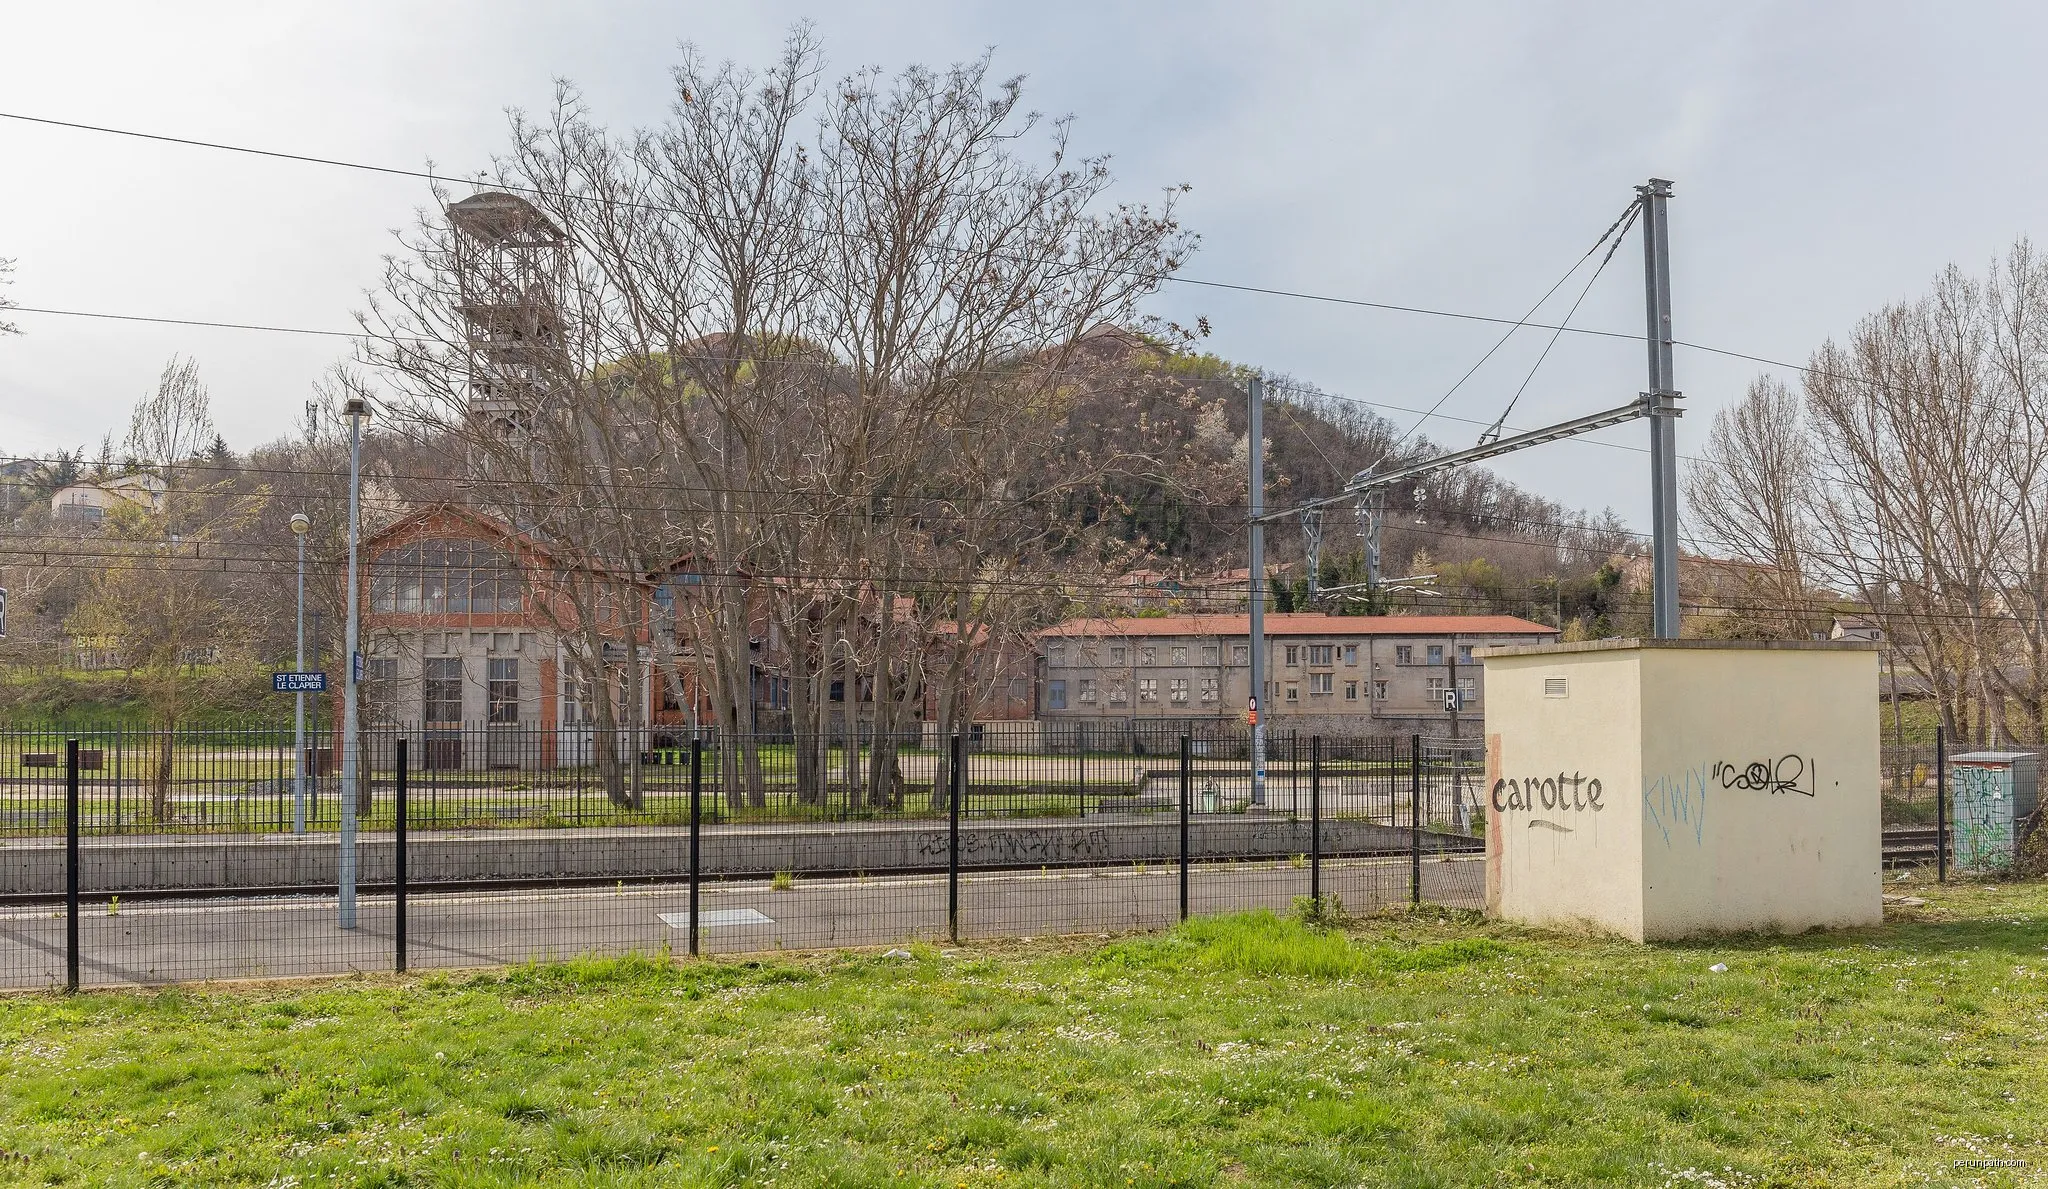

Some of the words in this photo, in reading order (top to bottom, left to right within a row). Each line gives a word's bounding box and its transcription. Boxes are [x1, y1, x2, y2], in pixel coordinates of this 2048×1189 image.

[276, 674, 287, 682] ST
[288, 674, 323, 682] ETIENNE
[277, 682, 287, 690] LE
[1445, 691, 1456, 709] R
[1491, 770, 1605, 813] carotte
